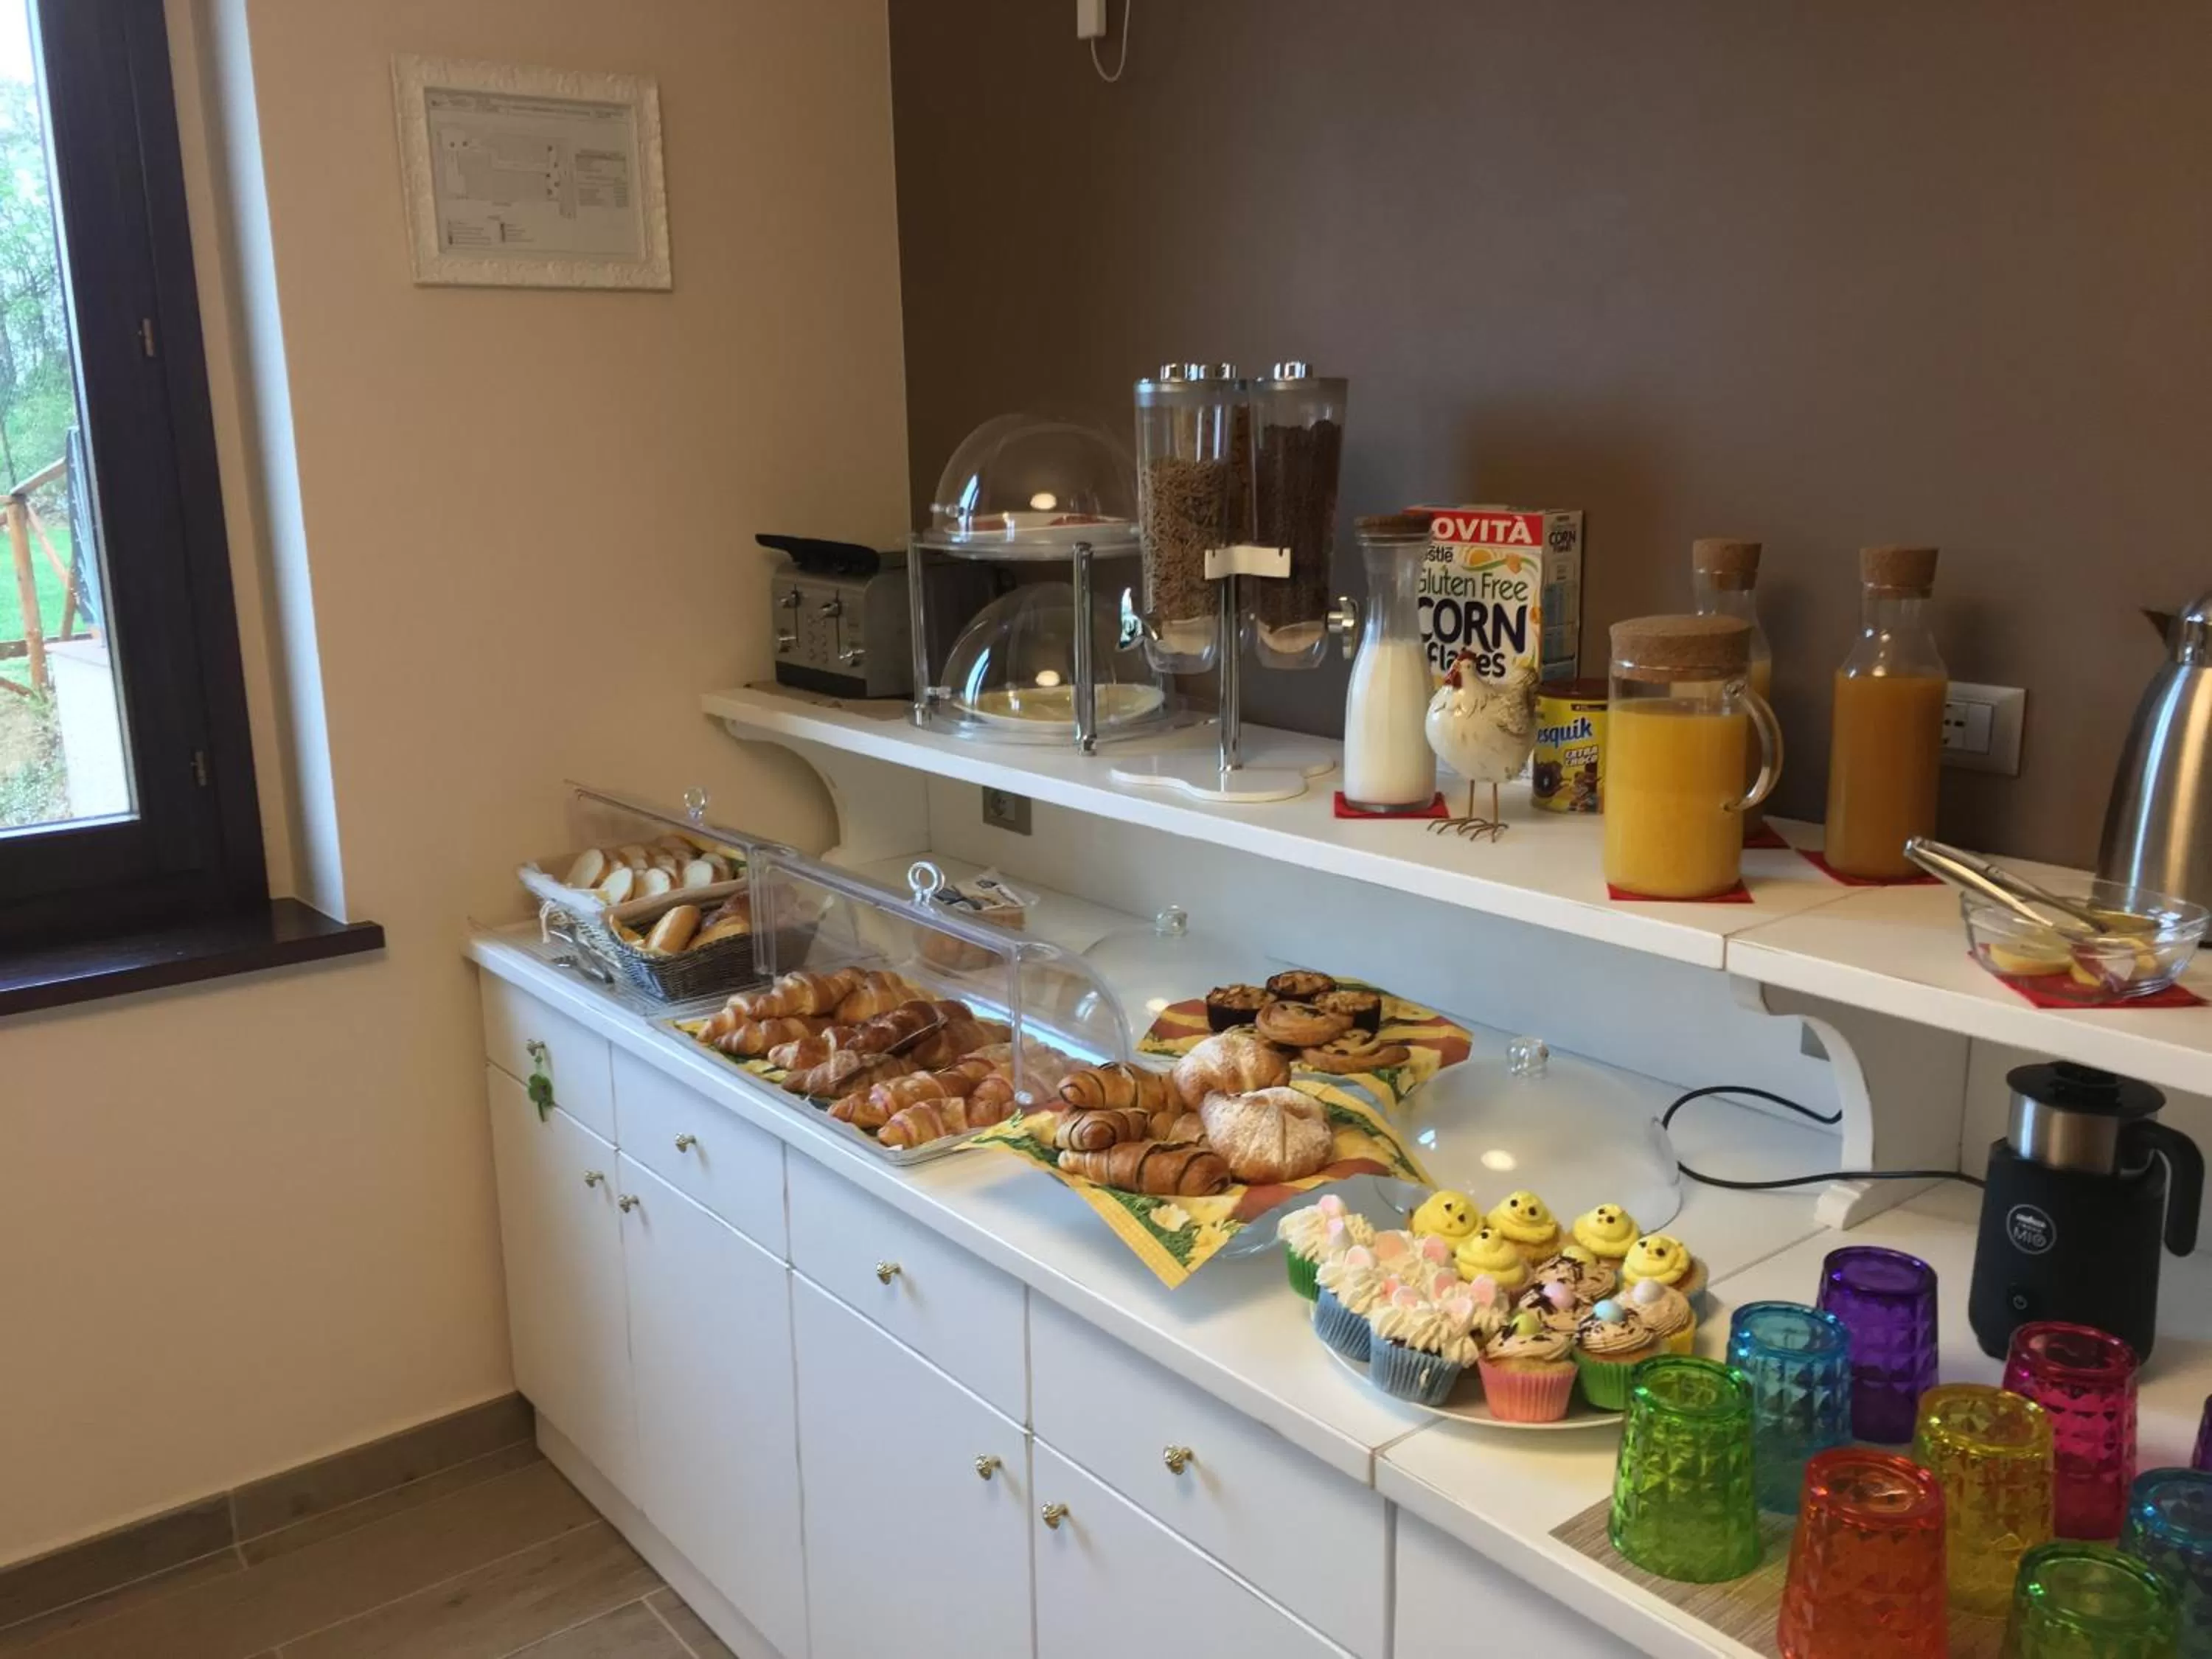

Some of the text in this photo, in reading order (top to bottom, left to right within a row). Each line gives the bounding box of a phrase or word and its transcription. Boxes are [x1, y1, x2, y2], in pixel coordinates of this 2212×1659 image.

[1431, 516, 1533, 544] OVITÀ
[1425, 545, 1454, 563] stlé
[1481, 572, 1528, 601] Free
[1427, 641, 1506, 678] flaes
[1537, 717, 1593, 749] squik
